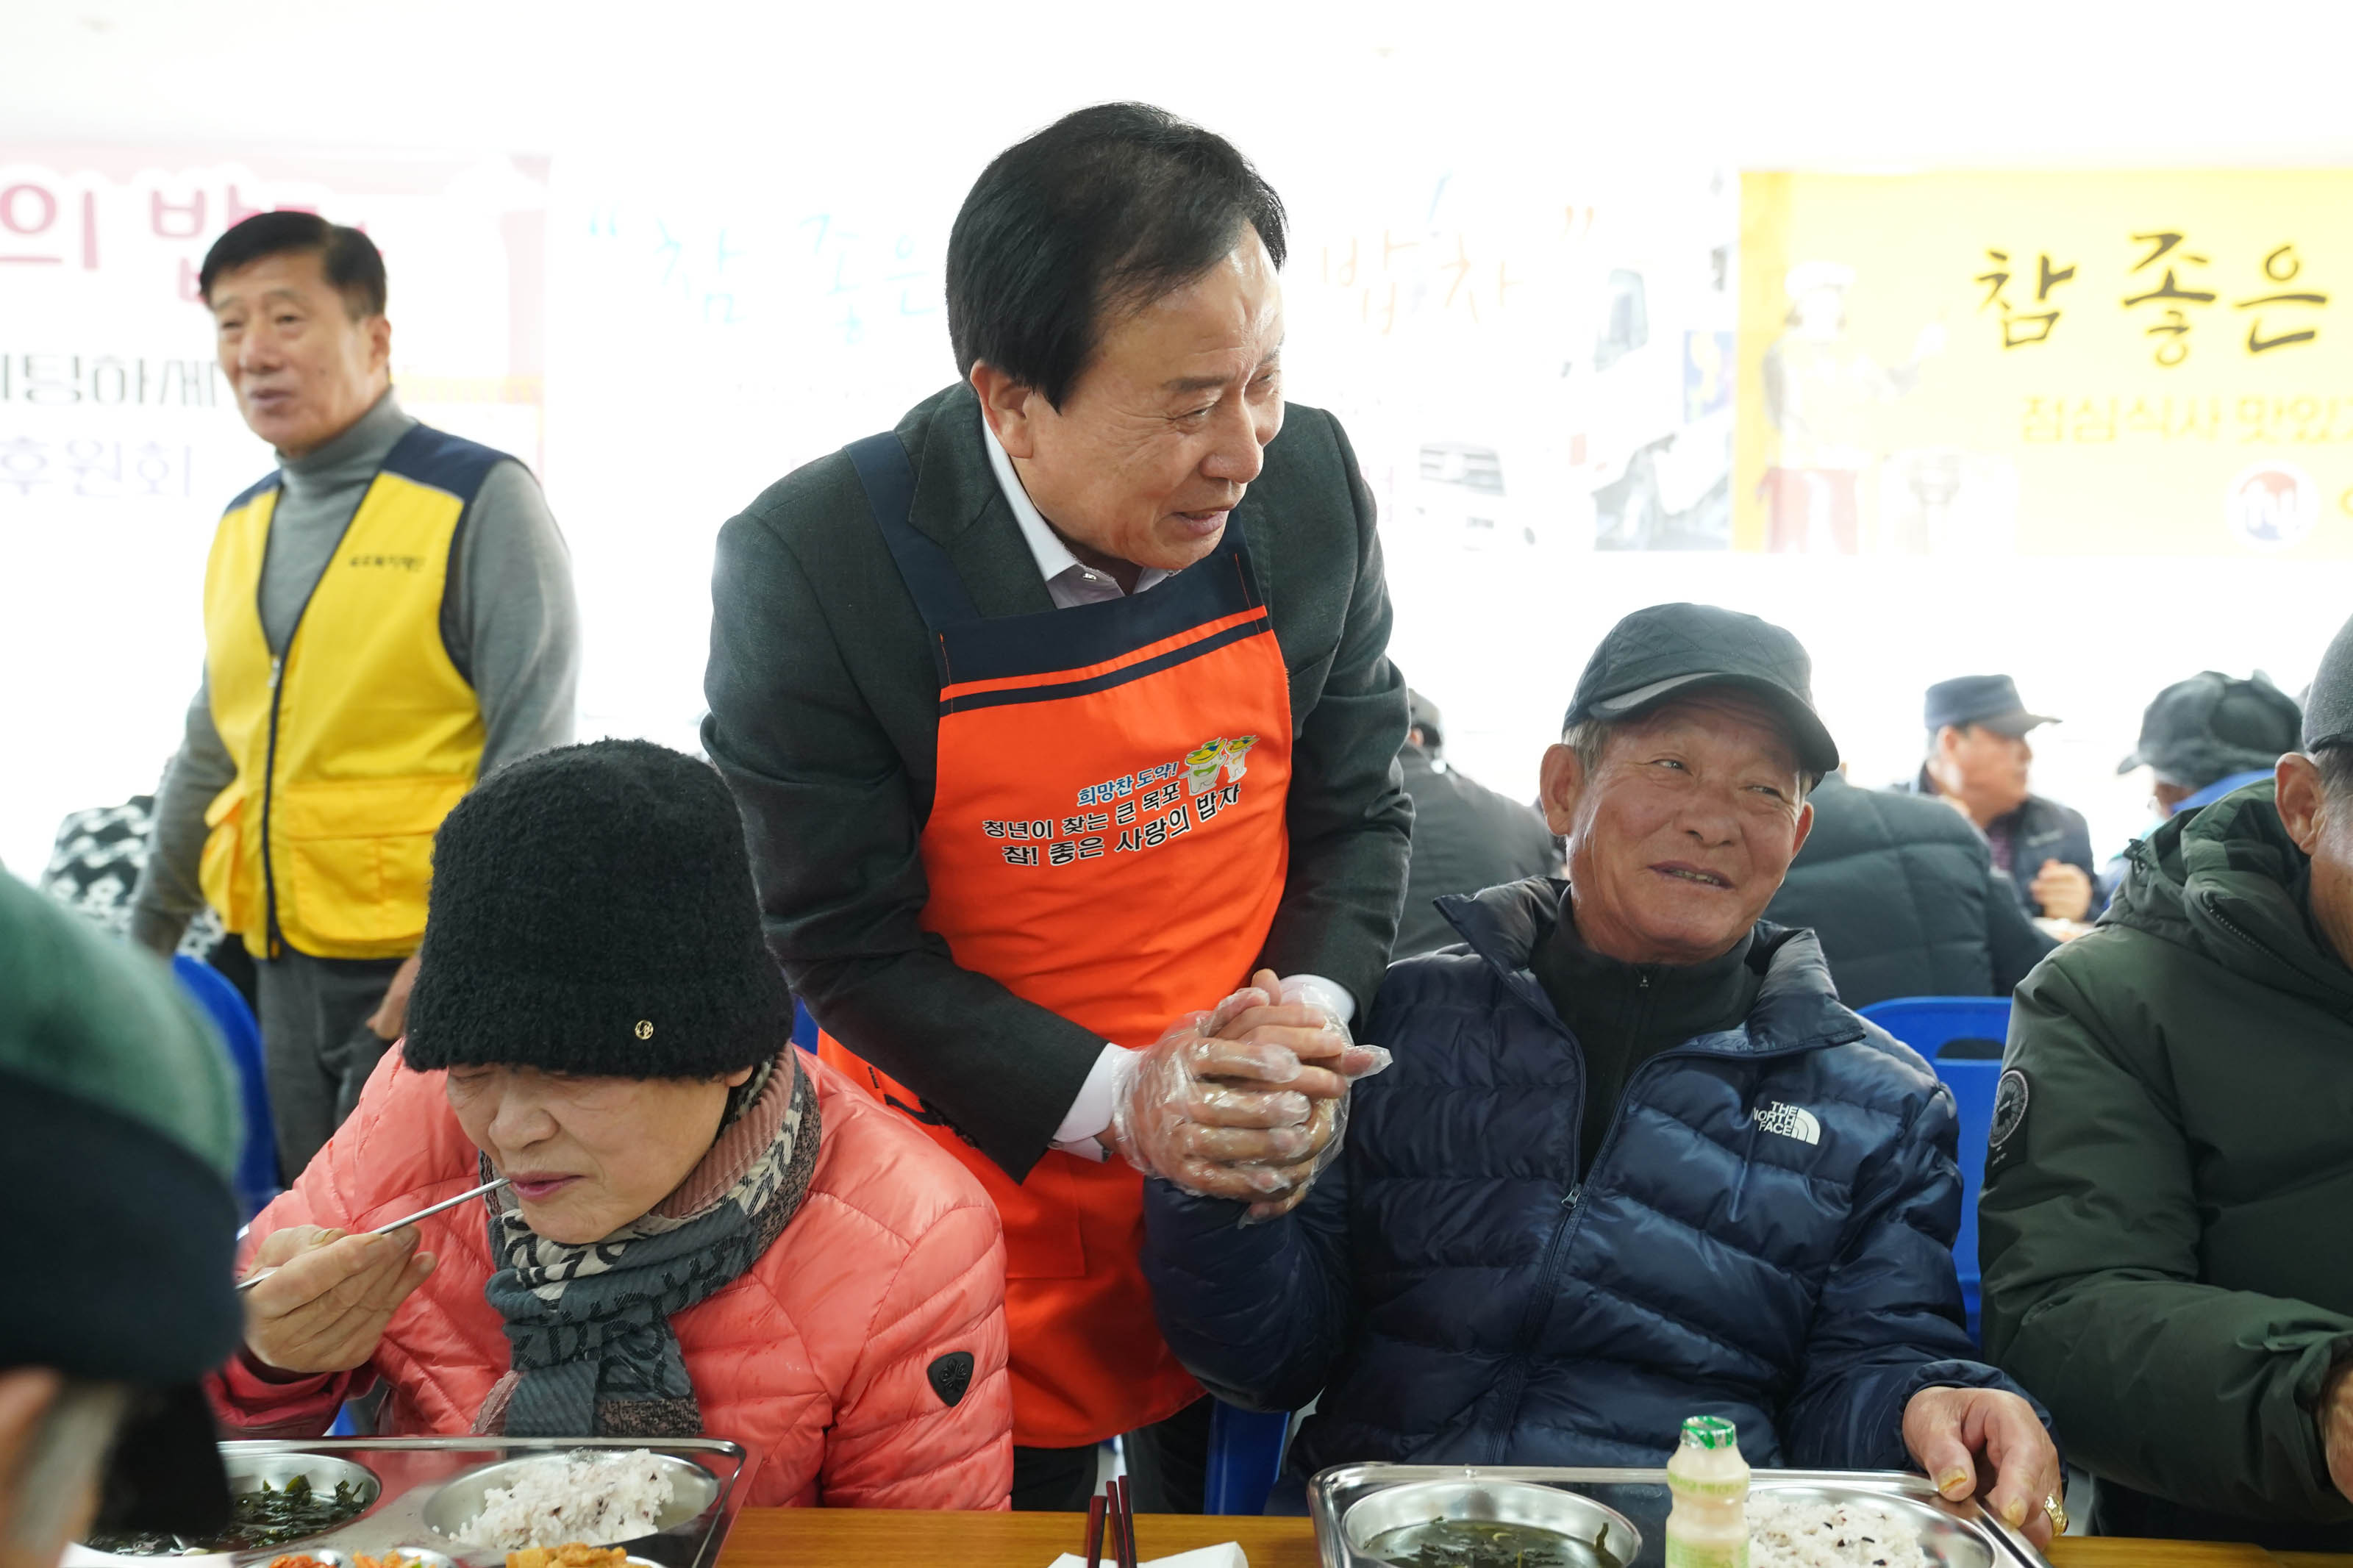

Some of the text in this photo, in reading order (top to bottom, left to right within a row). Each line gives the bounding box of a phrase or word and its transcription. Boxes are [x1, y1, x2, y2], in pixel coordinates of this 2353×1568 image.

[1974, 231, 2328, 366] 참 좋은
[2021, 394, 2221, 443] 점심식사
[1078, 762, 1178, 805] 희망찬 도약!
[983, 781, 1179, 839] 청년이 찾는 큰 목포
[1003, 845, 1038, 865] 참!
[1049, 837, 1104, 865] 좋은
[1115, 805, 1190, 851] 사랑의
[1753, 1106, 1795, 1128] NORTH
[1758, 1120, 1792, 1137] FACE
[1771, 1100, 1799, 1116] THE
